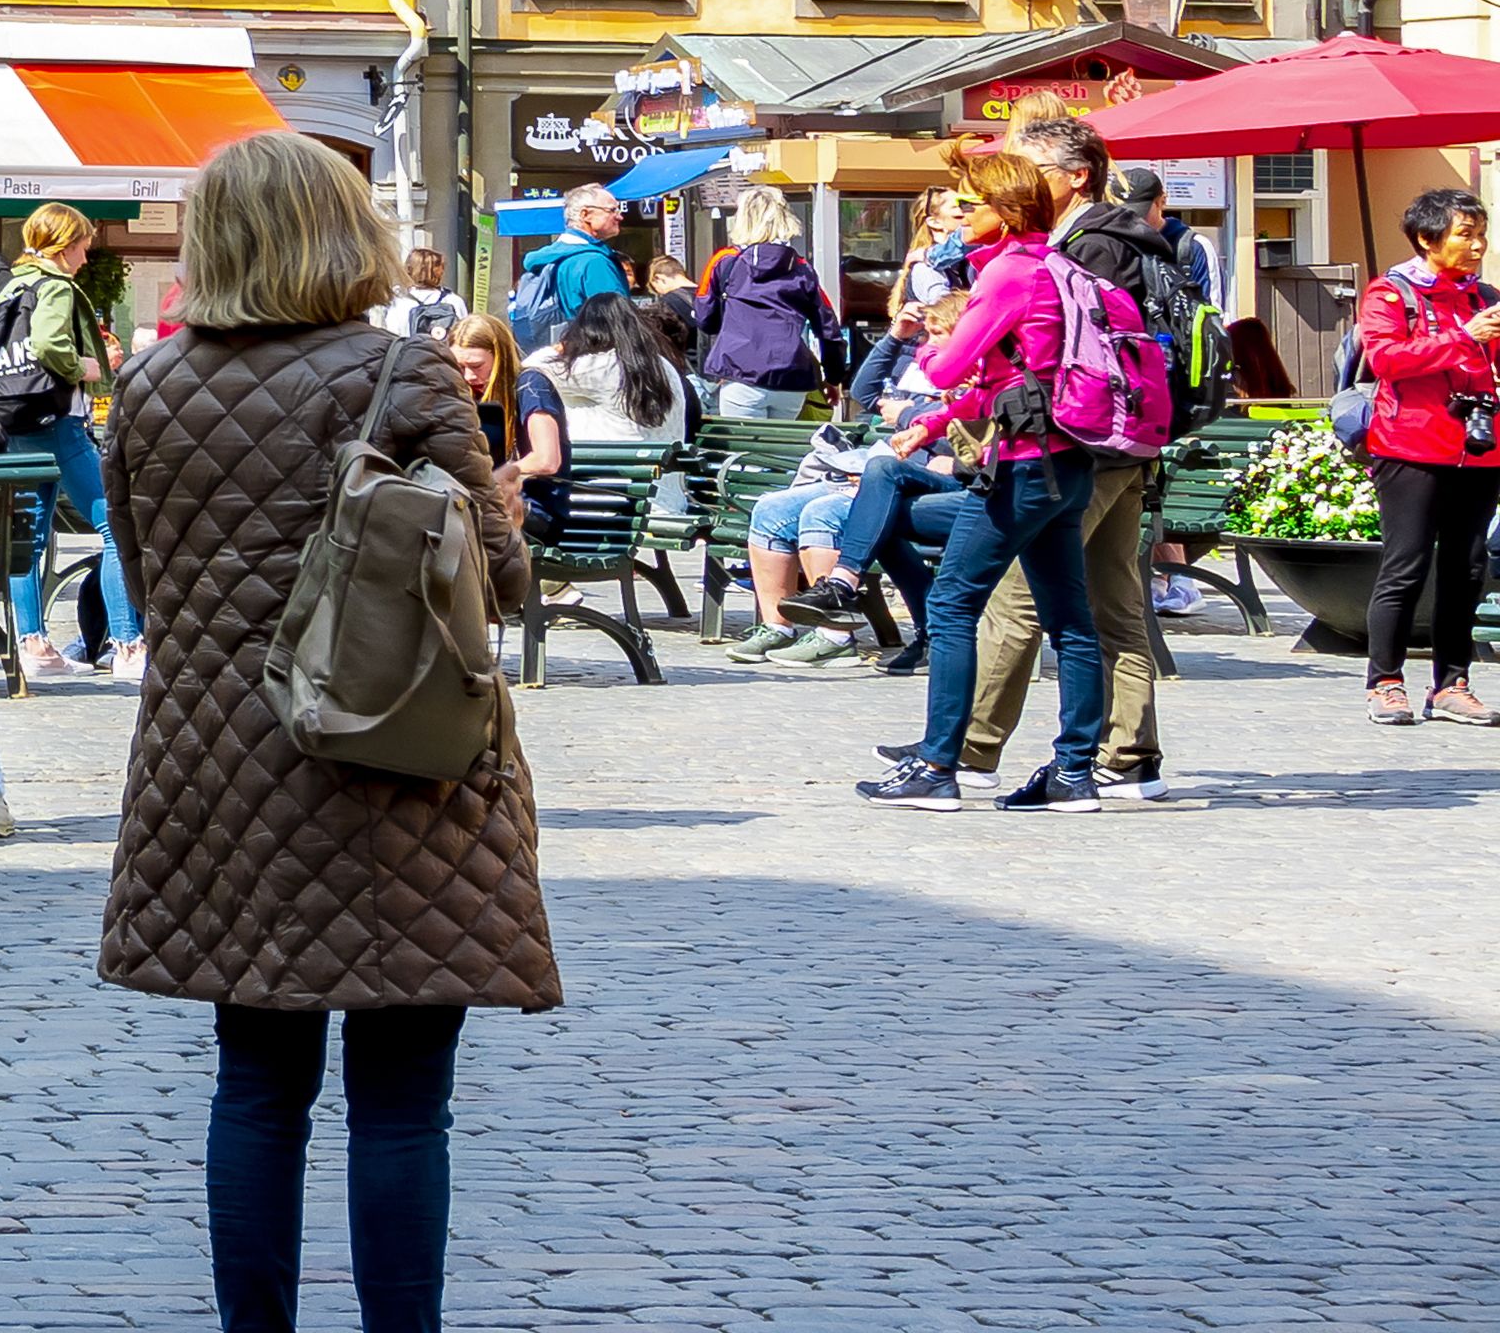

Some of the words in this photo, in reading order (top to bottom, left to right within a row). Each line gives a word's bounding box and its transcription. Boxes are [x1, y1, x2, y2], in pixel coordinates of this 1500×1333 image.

[989, 81, 1089, 100] Spaish
[4, 178, 40, 195] Pasta
[132, 180, 159, 197] Grill
